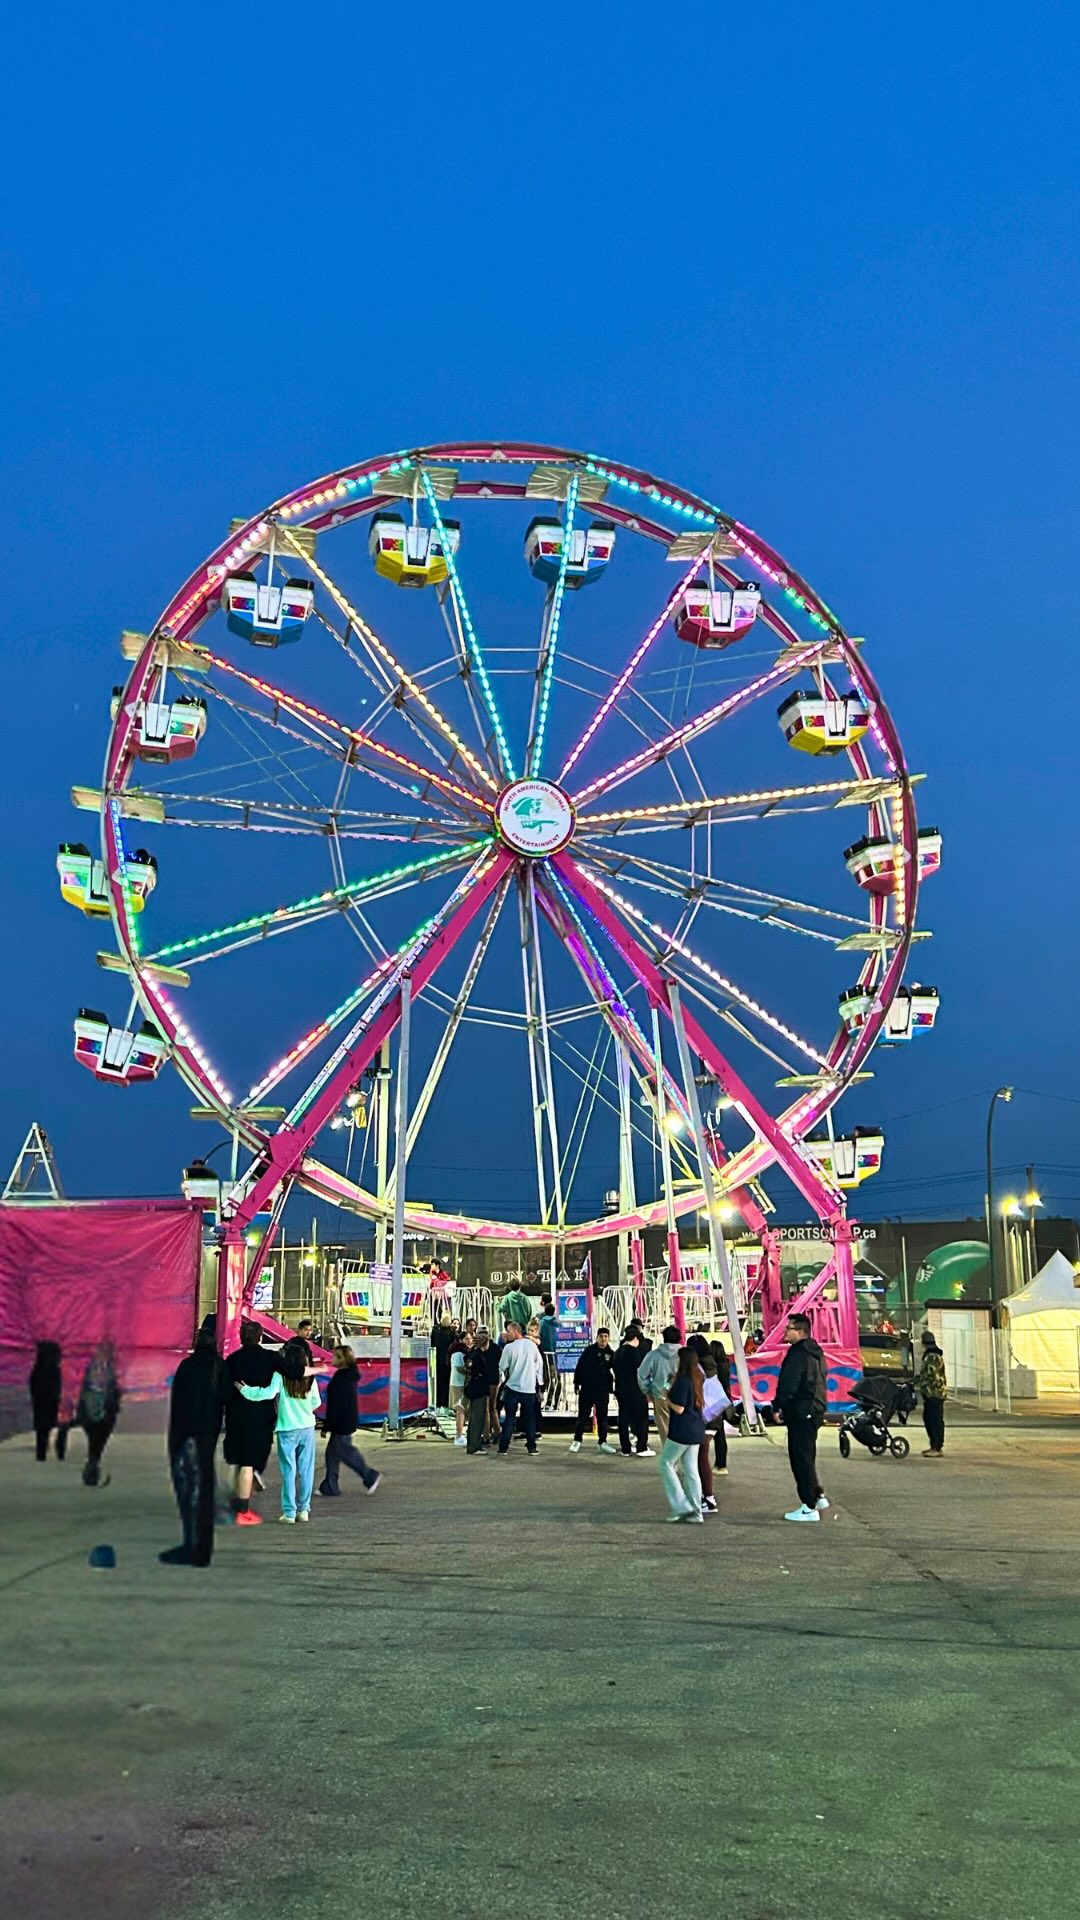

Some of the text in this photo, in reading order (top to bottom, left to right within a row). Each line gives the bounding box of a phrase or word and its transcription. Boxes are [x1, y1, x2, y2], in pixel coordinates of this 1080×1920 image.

[504, 784, 567, 812] NORTH AMERICAN MIDWAY
[511, 832, 560, 848] ENTERTAINMENT
[490, 1270, 524, 1283] ON
[568, 1296, 578, 1309] 6
